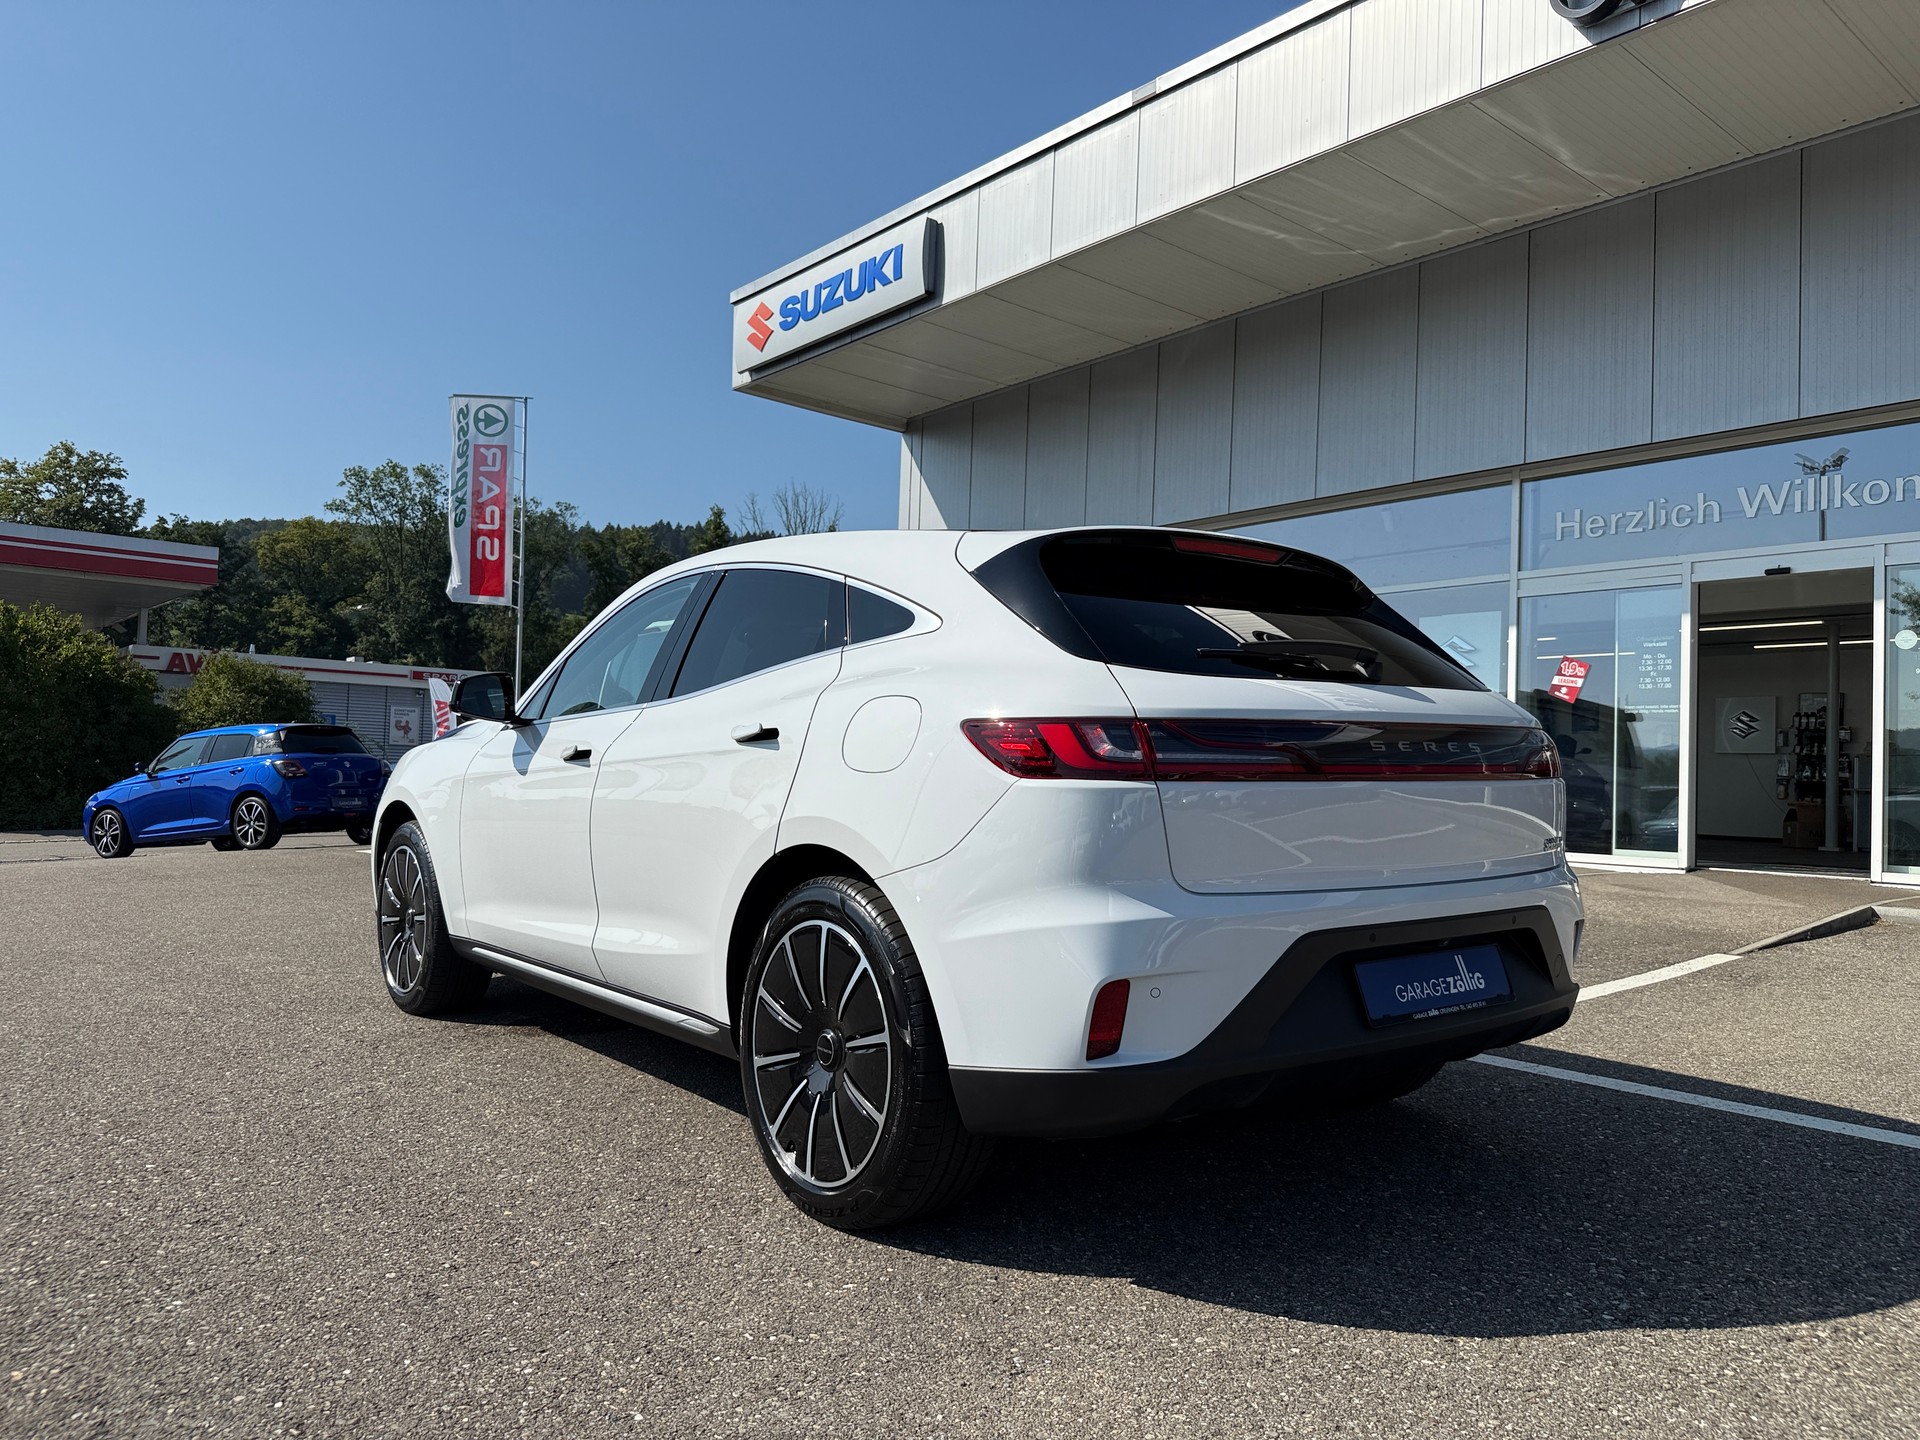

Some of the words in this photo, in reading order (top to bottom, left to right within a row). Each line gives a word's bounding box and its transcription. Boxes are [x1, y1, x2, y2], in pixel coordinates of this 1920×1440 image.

[779, 243, 903, 331] SUZUKI
[1555, 492, 1721, 541] Herzlich
[423, 672, 457, 681] SPAR
[1369, 740, 1481, 752] SERES
